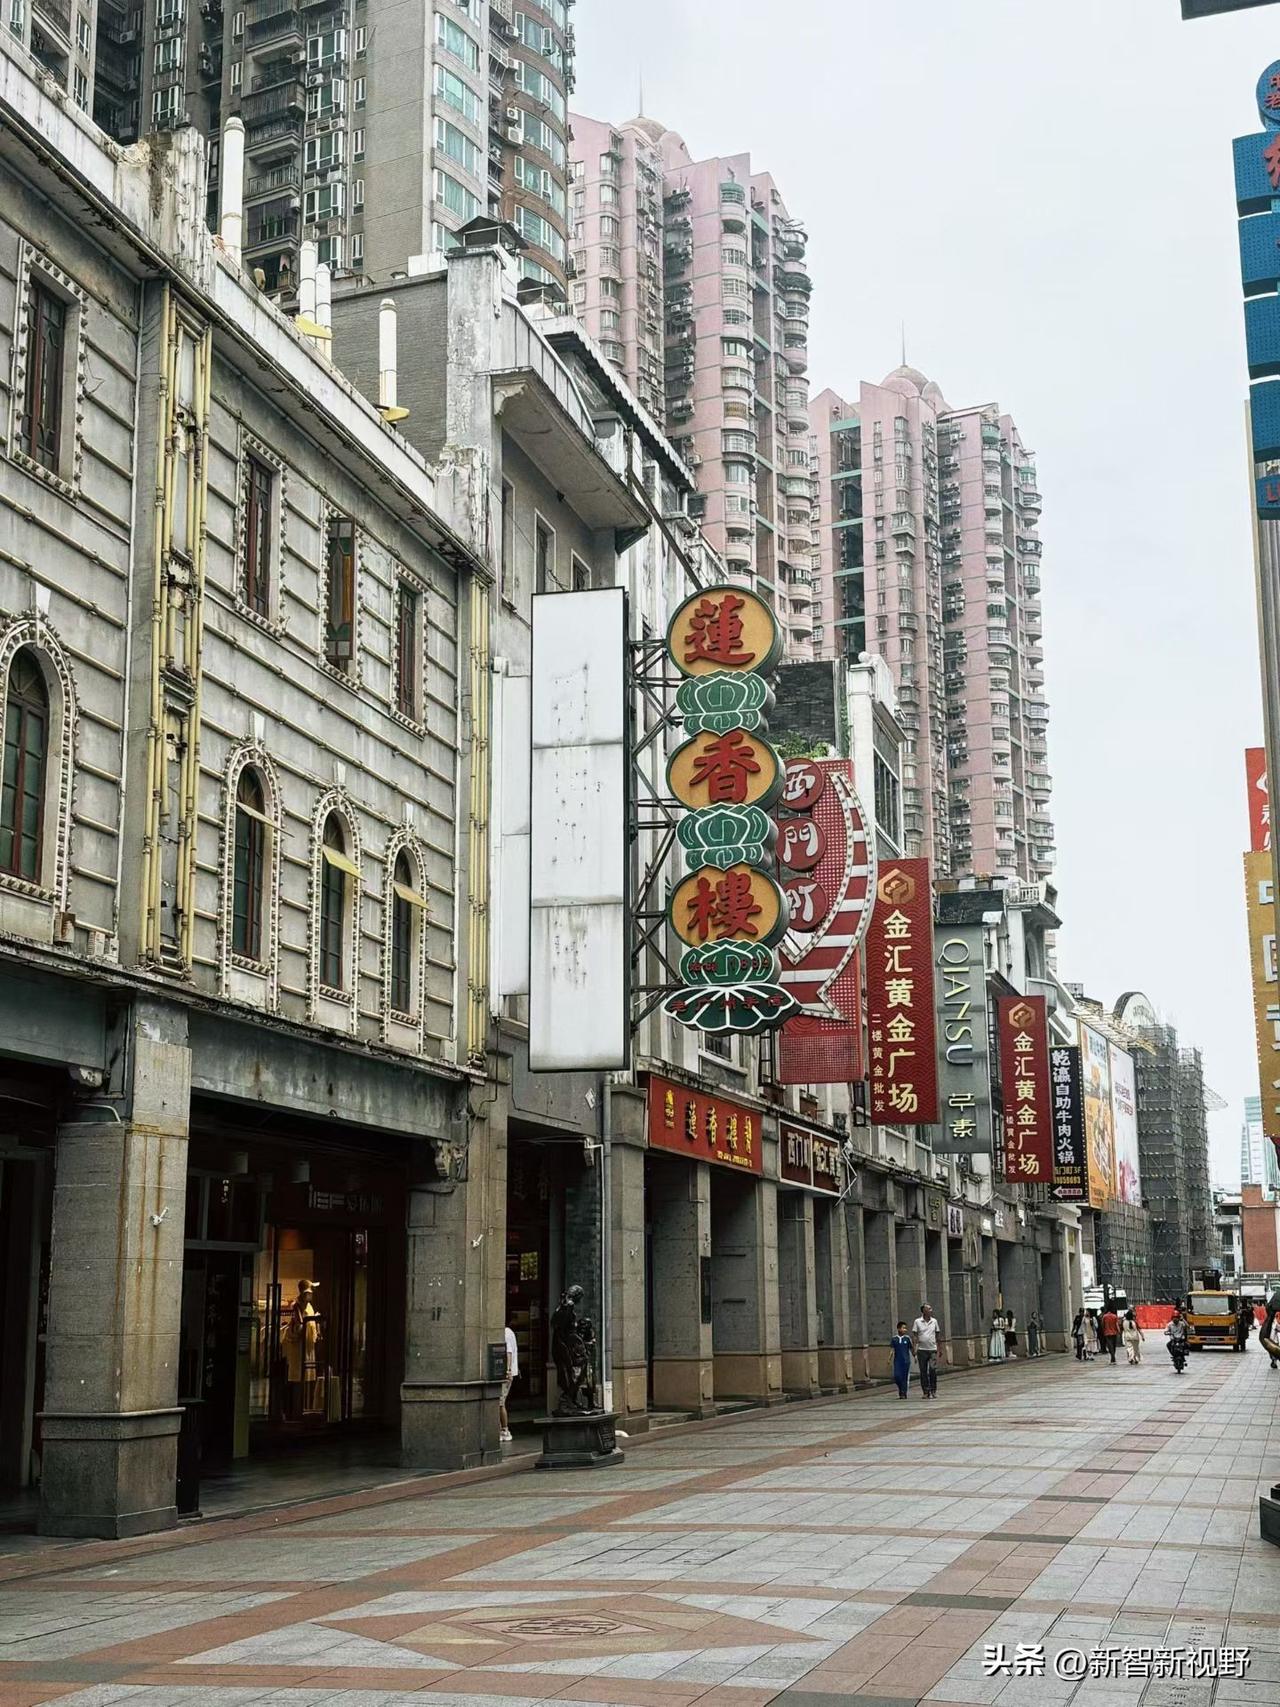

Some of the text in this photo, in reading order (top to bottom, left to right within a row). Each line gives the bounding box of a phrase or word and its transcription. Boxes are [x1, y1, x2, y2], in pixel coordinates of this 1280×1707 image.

[684, 595, 761, 940] 蓮香樓
[872, 1013, 886, 1113] 二楼黄金批发
[883, 909, 918, 1114] 金汇黄金广场
[937, 938, 974, 1066] QIANSU
[1012, 1031, 1040, 1176] 金汇黄金广场
